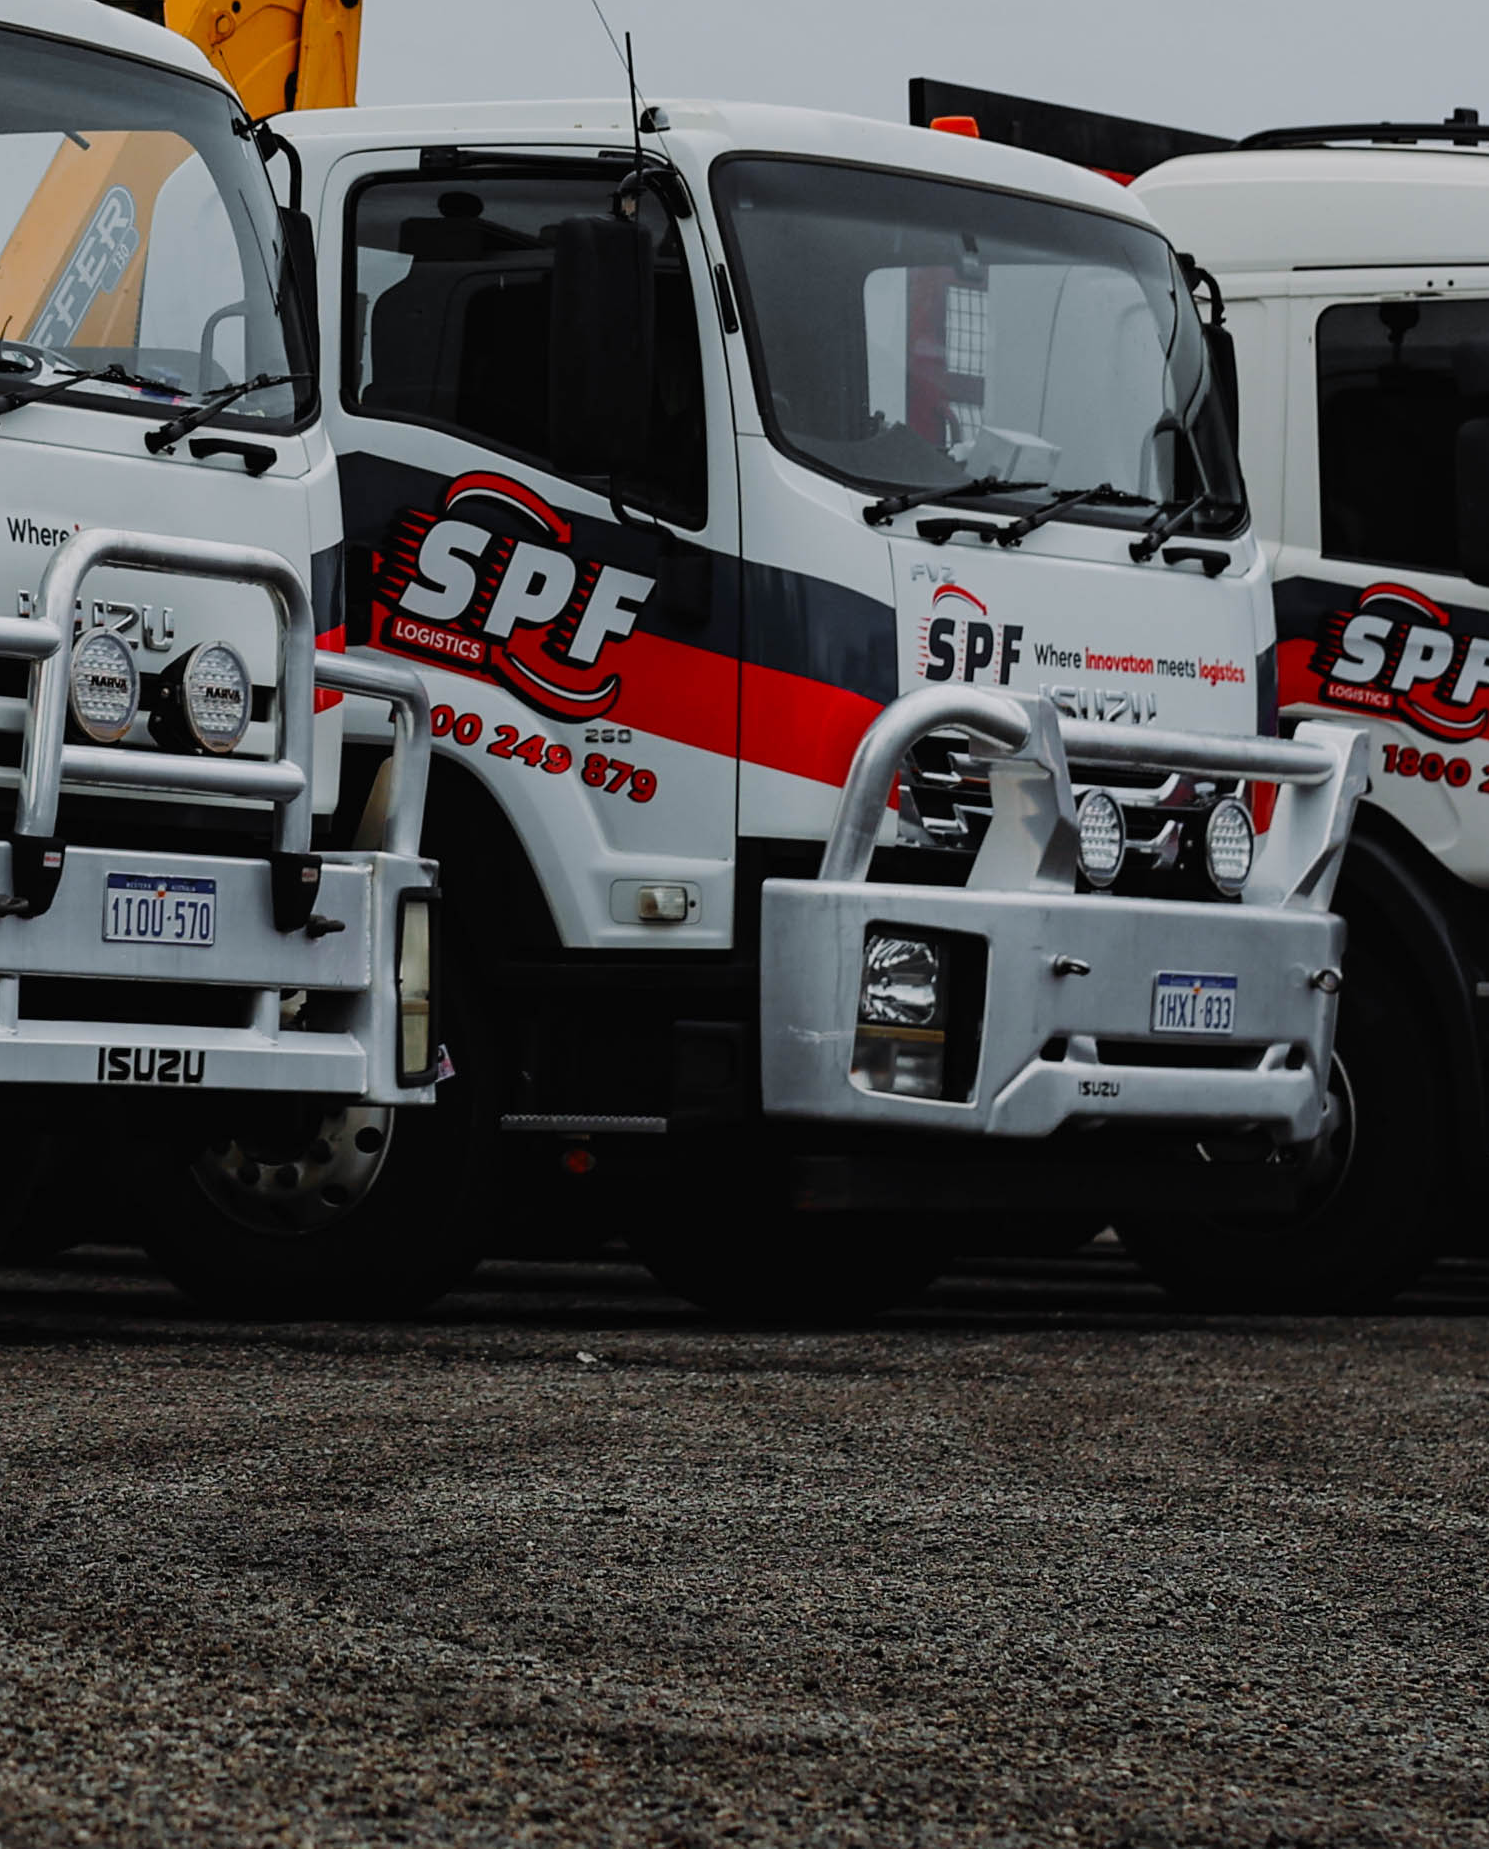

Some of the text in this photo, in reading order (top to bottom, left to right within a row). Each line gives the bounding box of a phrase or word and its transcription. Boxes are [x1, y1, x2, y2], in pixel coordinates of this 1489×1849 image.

[33, 197, 129, 348] FFER
[7, 517, 70, 548] Where
[398, 520, 656, 663] SPF
[911, 562, 958, 584] FVZ
[18, 590, 174, 651] IUZU
[395, 621, 481, 659] LOGISTICS
[925, 618, 1023, 685] SPF
[90, 674, 127, 690] NARVA
[1035, 643, 1245, 686] Where innovation meets logistics
[206, 686, 240, 702] NARVA
[1329, 686, 1389, 707] LOGISTICS
[486, 725, 573, 774] 249
[581, 753, 657, 803] 879
[1382, 743, 1471, 787] 1800
[97, 1047, 205, 1083] ISUZU
[1078, 1081, 1119, 1097] ISUZU
